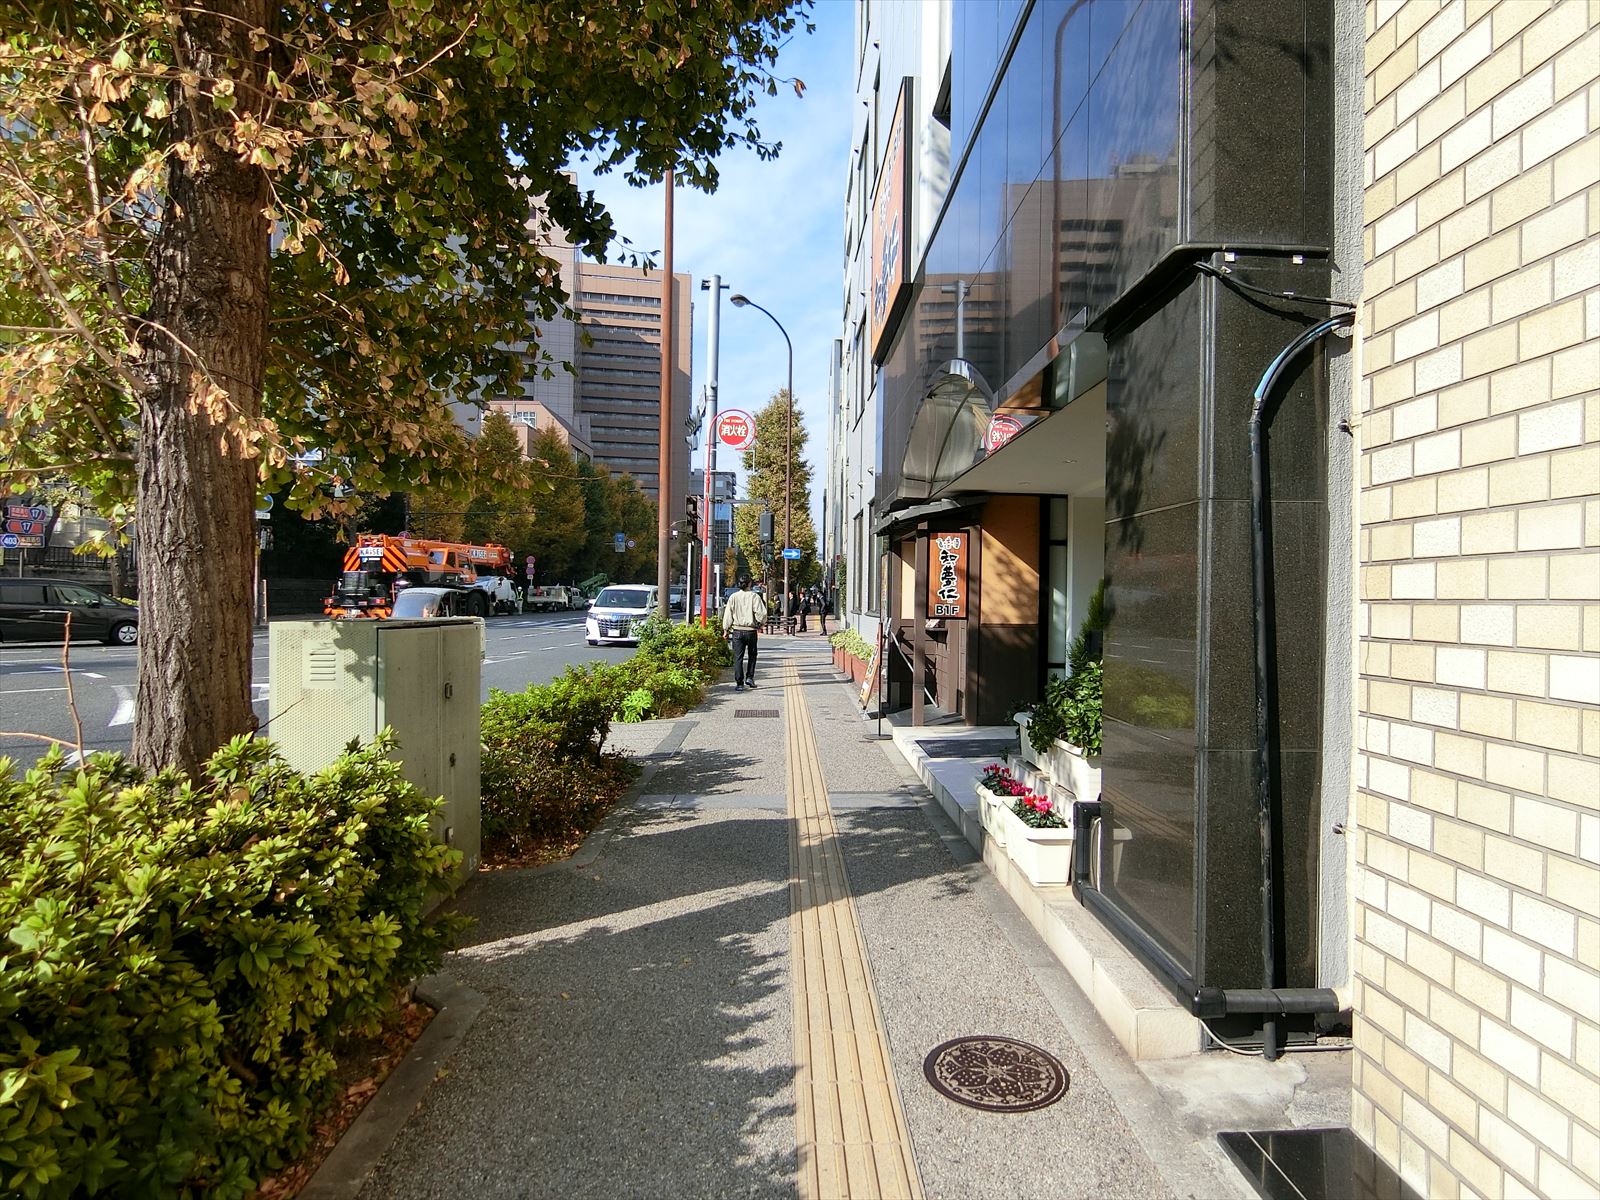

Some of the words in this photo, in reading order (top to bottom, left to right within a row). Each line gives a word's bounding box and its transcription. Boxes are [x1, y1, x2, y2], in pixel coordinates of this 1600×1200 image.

[721, 424, 746, 436] 消火栓
[31, 509, 39, 517] 17
[22, 522, 31, 530] 17
[935, 604, 960, 615] B1F
